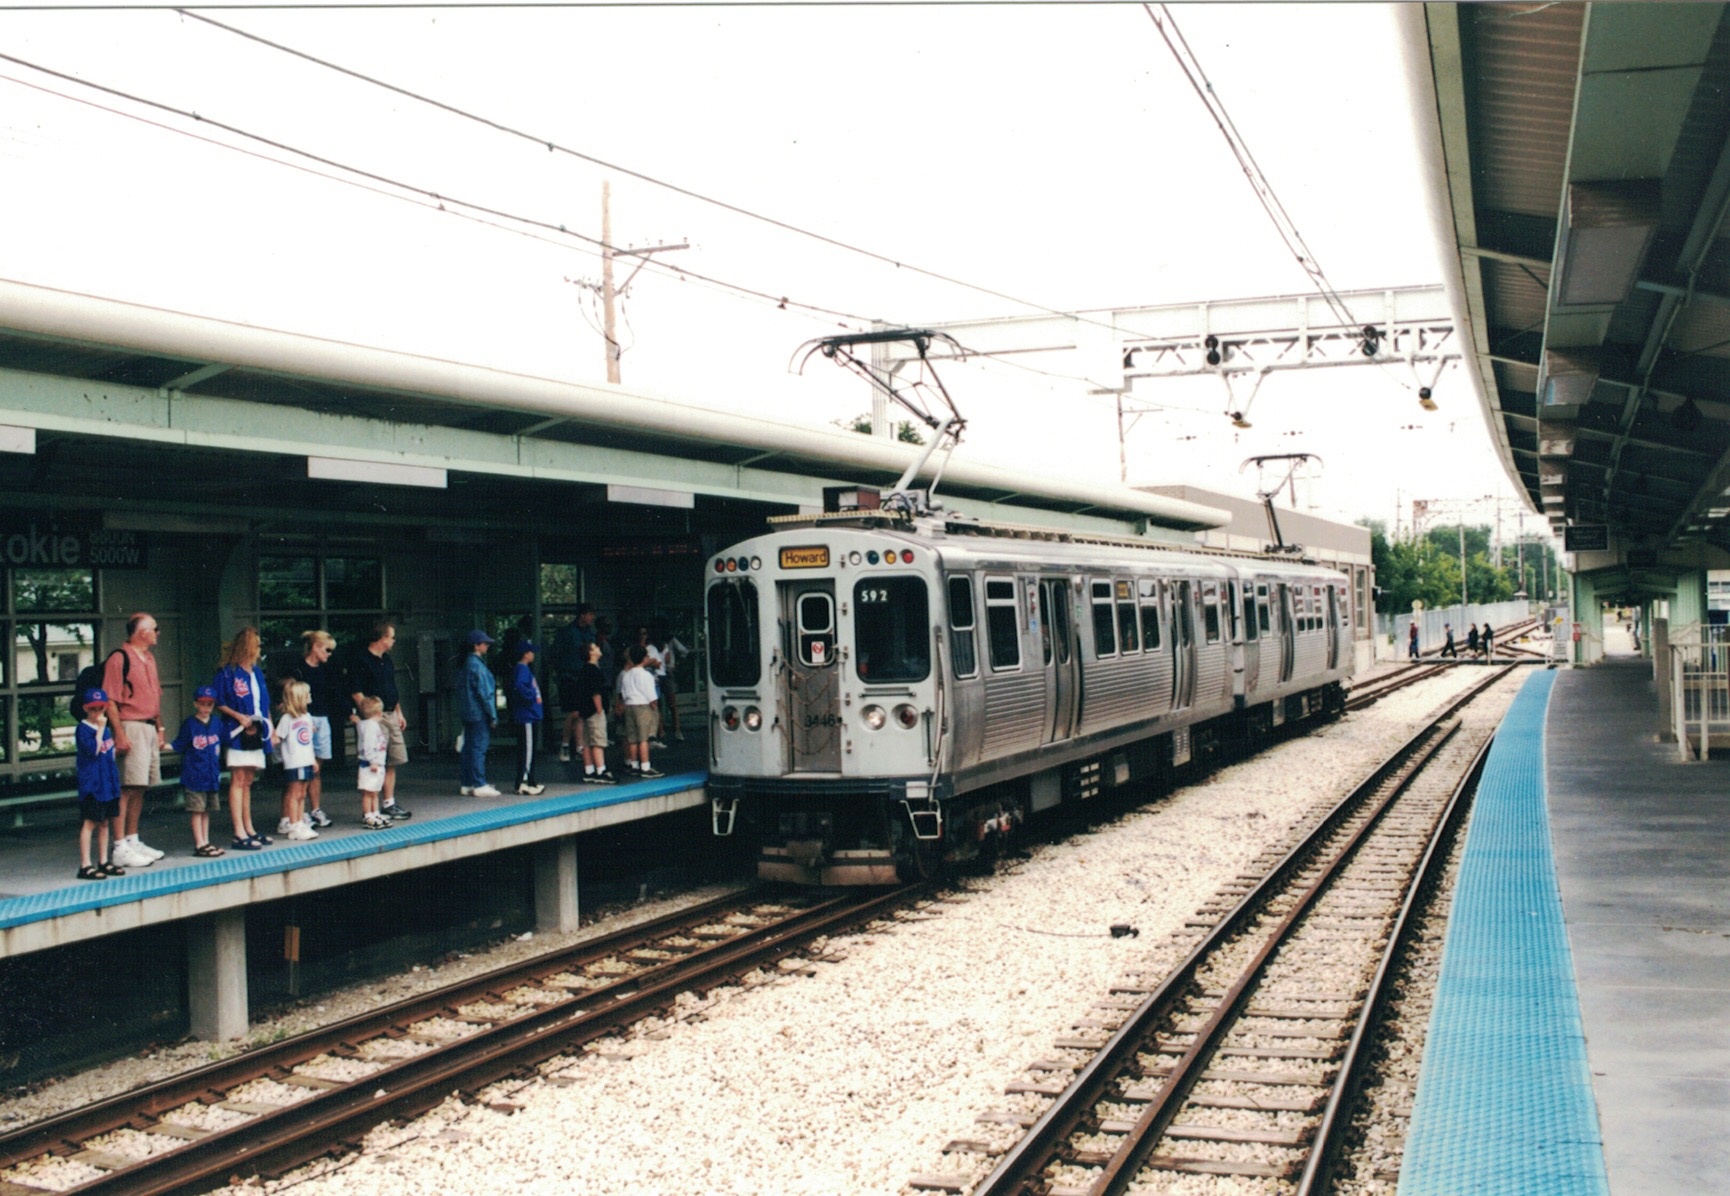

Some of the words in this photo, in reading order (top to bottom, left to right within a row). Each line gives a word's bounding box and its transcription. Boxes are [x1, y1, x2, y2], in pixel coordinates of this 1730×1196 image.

[89, 547, 140, 564] 5000W
[785, 551, 827, 564] Howard
[861, 590, 888, 602] 592
[805, 713, 836, 728] 3446
